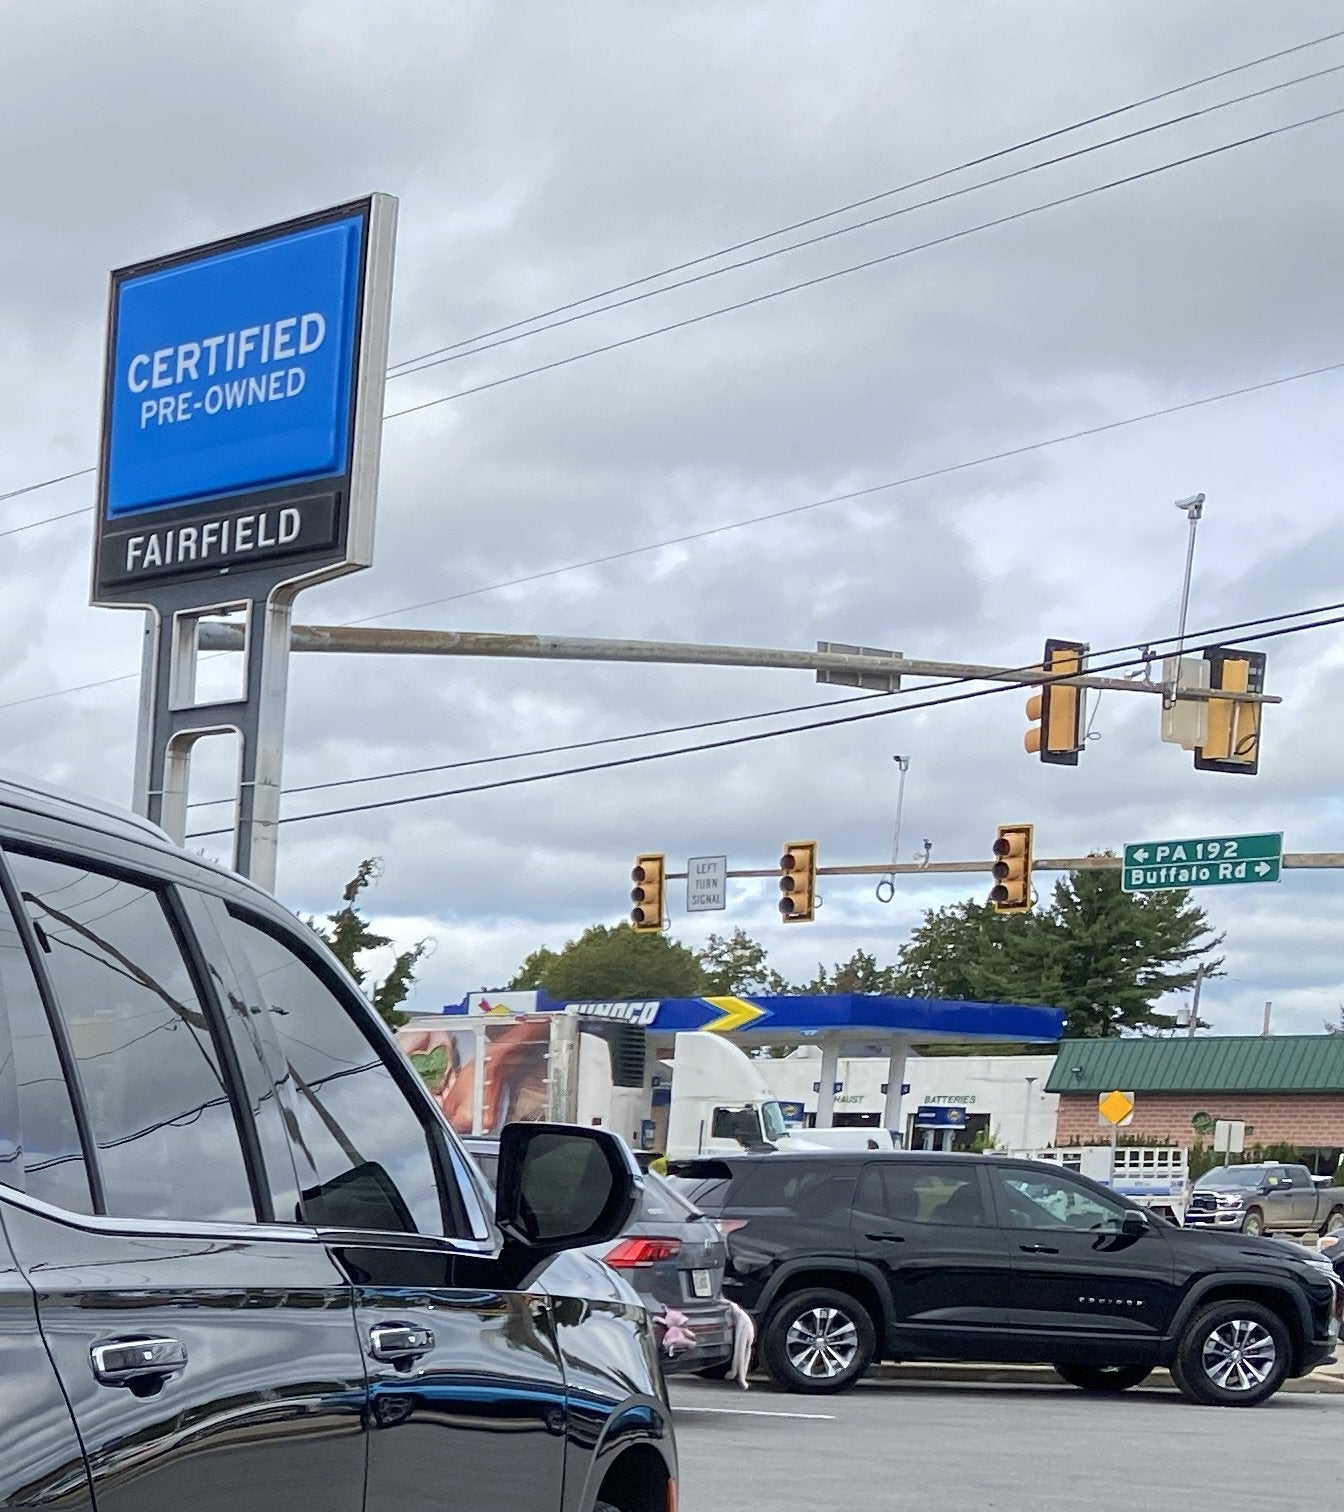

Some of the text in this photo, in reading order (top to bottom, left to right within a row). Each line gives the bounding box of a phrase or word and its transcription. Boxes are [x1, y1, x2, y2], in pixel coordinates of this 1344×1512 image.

[127, 312, 326, 394] CERTIFIED
[140, 367, 306, 430] PRE-OWNED
[126, 507, 301, 572] FAIRFIELD
[1156, 841, 1238, 863] PA 192
[696, 862, 718, 875] LEFT
[1131, 862, 1246, 885] Buffalo Rd
[695, 878, 718, 890] TURN
[691, 893, 721, 905] SIGNAL
[832, 1094, 865, 1104] HAUST
[924, 1094, 976, 1105] BATTERIES
